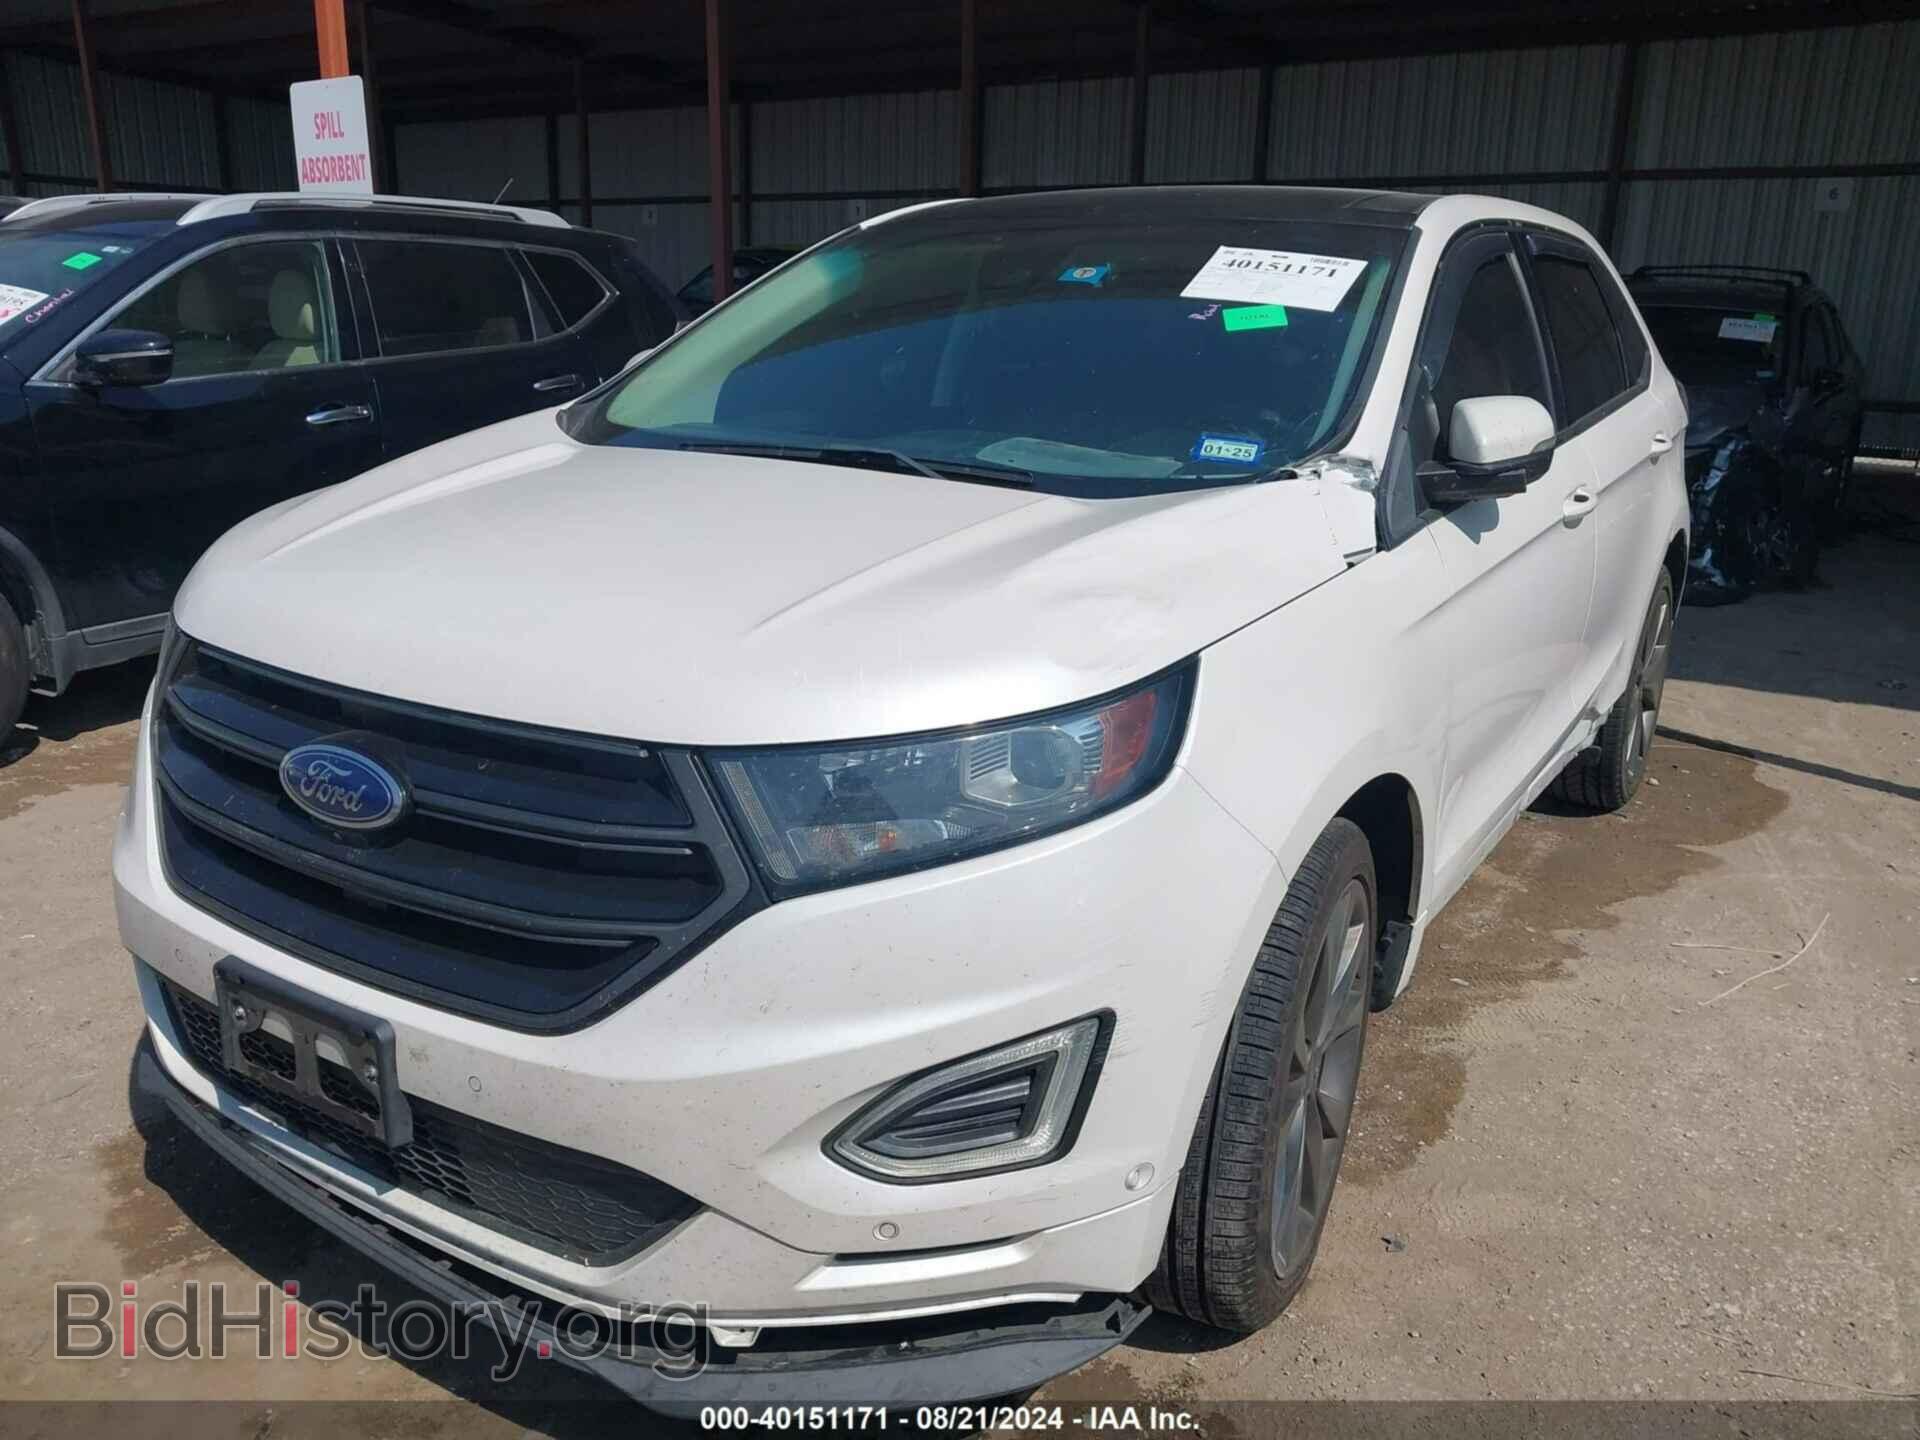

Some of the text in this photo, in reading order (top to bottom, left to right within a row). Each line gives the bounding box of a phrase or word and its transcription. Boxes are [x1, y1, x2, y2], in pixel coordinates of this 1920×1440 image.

[313, 111, 345, 140] SPILL
[301, 153, 366, 184] ABSORBENT
[1222, 258, 1337, 278] 40151171
[299, 759, 368, 813] Ford
